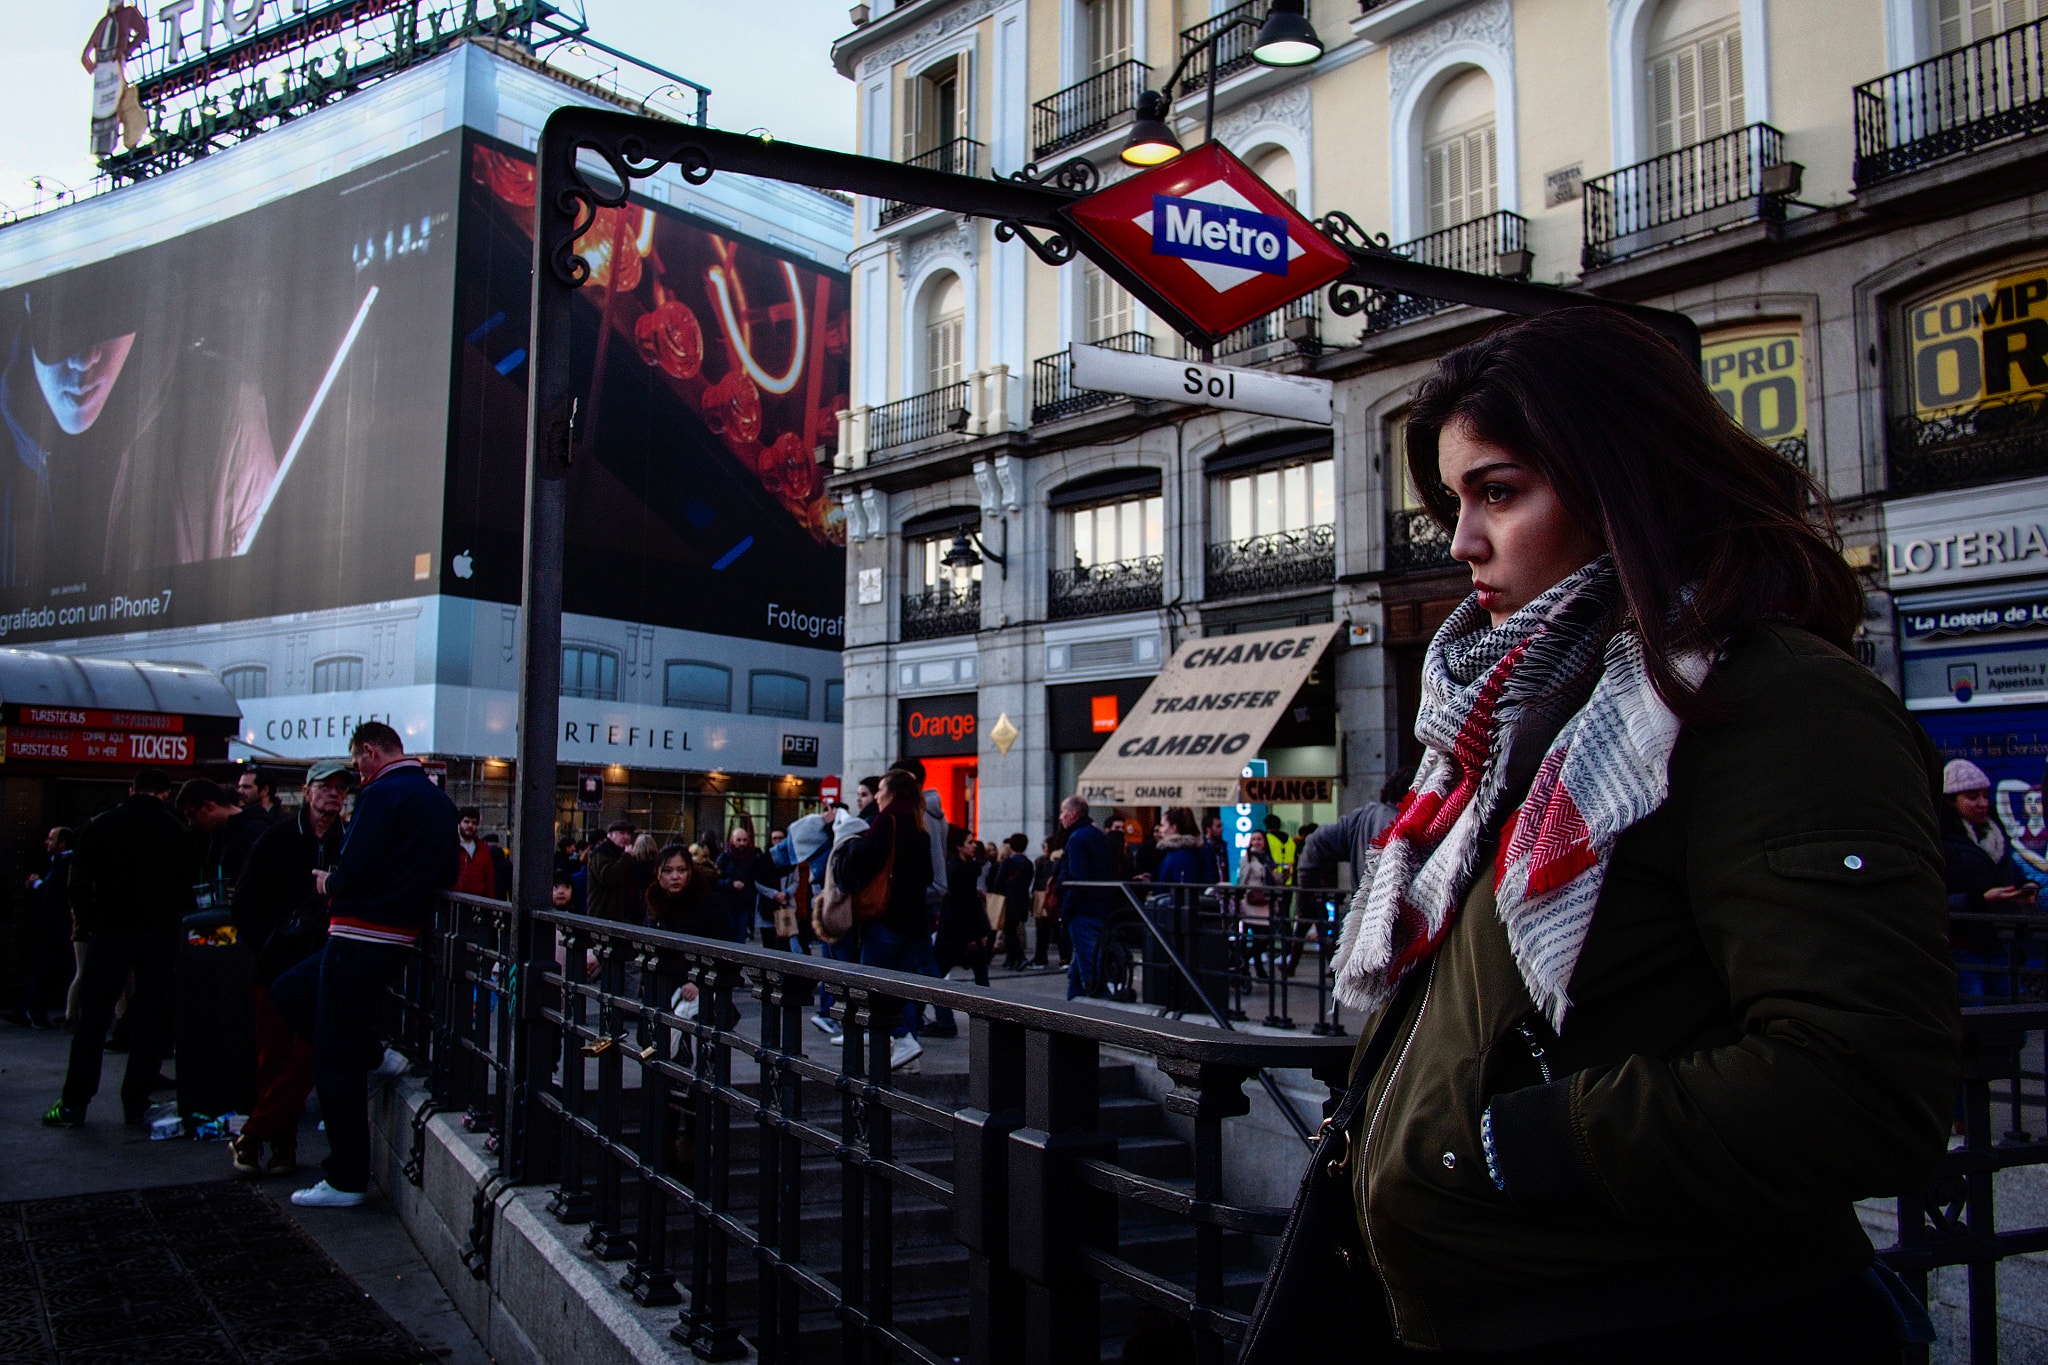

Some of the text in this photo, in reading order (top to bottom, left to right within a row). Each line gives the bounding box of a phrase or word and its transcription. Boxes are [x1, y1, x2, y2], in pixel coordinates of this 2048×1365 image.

[150, 76, 186, 103] SOL
[193, 60, 222, 88] DE
[228, 12, 343, 74] ANDALUCIA
[1165, 204, 1281, 261] Metro
[1914, 278, 2048, 342] COMP
[1703, 339, 1796, 385] PRO
[1916, 318, 2048, 409] OR
[1184, 367, 1235, 399] Sol
[1887, 524, 2048, 577] LOTERIA
[58, 606, 86, 625] con
[88, 603, 107, 622] un
[109, 596, 160, 620] iPhone
[162, 589, 172, 613] 7
[2003, 605, 2027, 622] de
[1183, 636, 1316, 669] CHANGE
[30, 708, 69, 723] TURISTIC
[69, 711, 87, 725] BUS
[1151, 690, 1280, 714] TRANSFER
[564, 721, 692, 752] RTEFIEL
[908, 711, 975, 741] Orange
[12, 741, 69, 757] TURISTIC BUS
[129, 734, 188, 761] TICKETS
[784, 736, 817, 753] DEFI
[1118, 733, 1251, 757] CAMBIO
[1135, 786, 1182, 798] CHANGE
[1245, 780, 1329, 800] CHANGE
